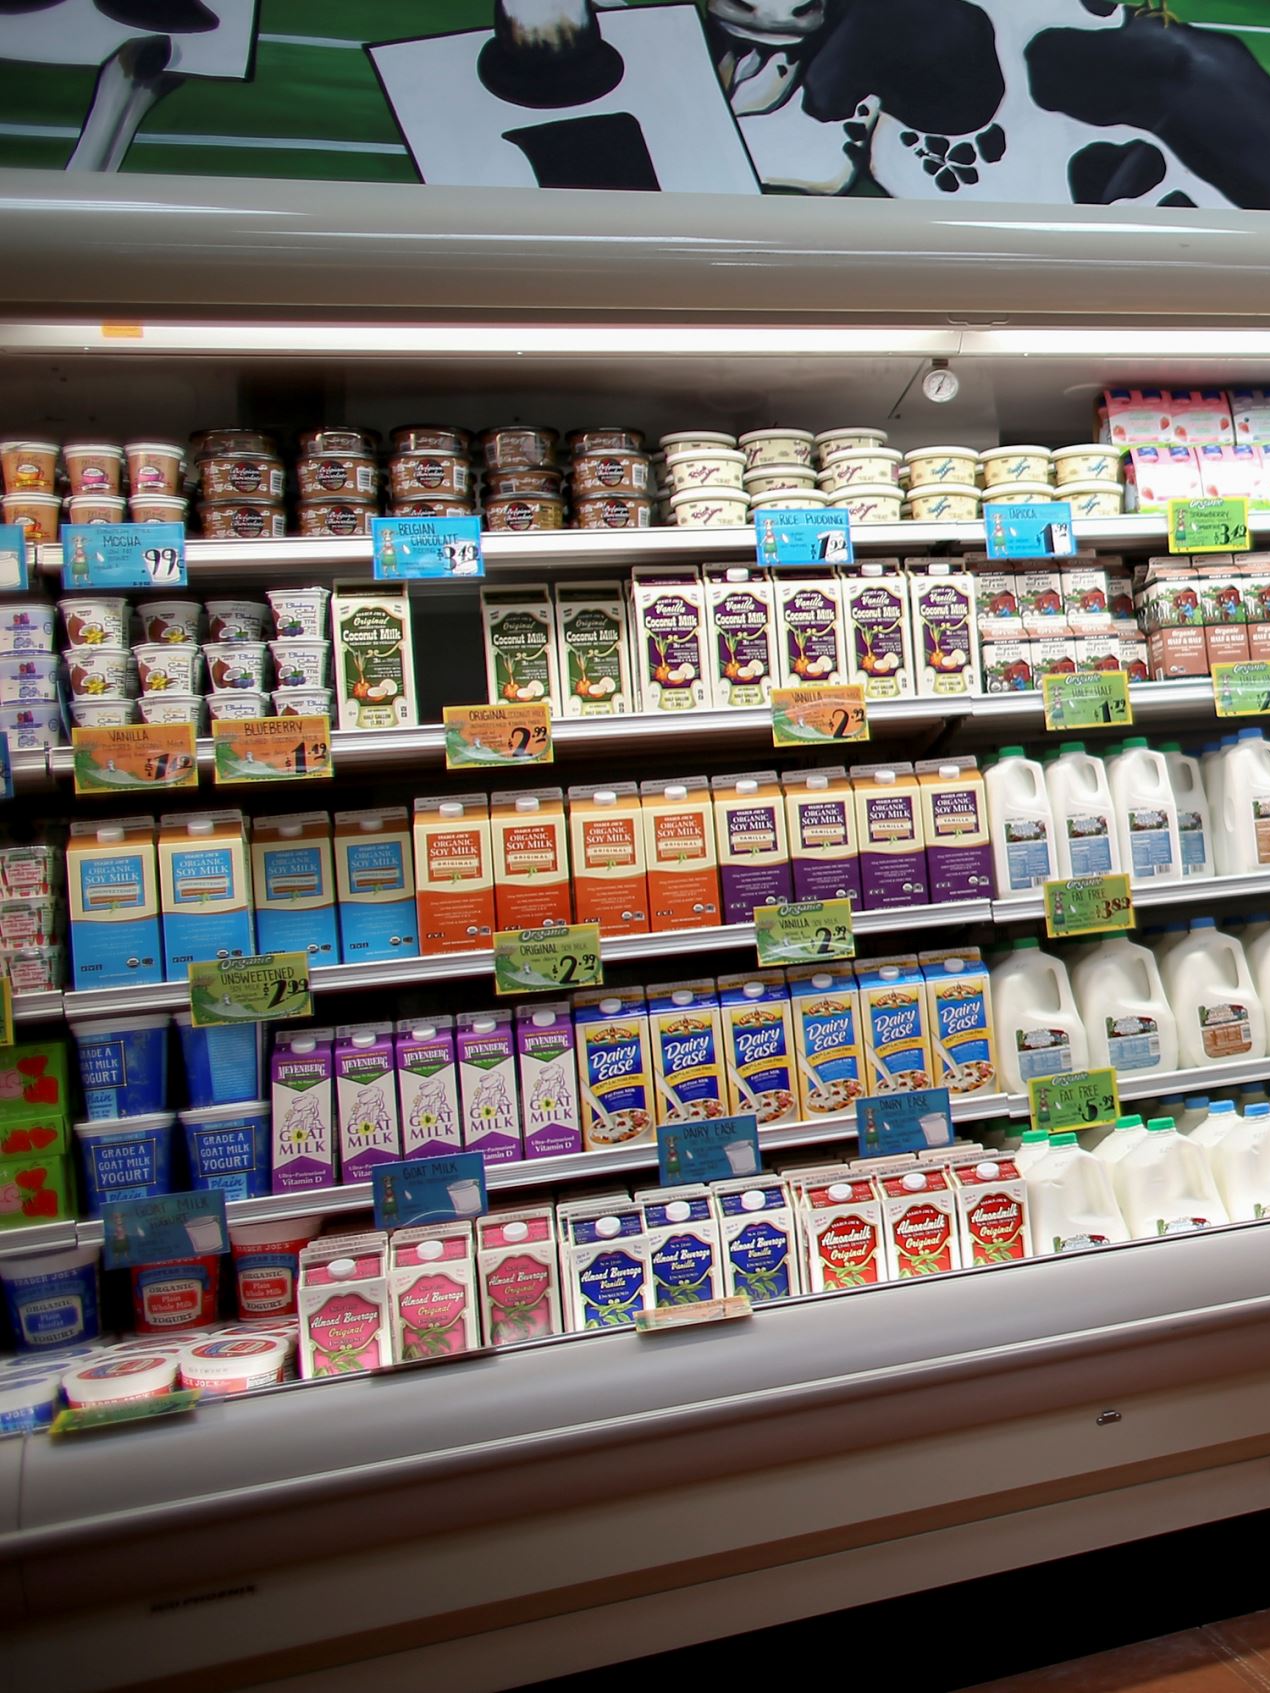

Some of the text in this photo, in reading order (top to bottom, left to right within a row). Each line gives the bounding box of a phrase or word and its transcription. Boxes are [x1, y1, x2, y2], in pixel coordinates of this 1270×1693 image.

[779, 513, 844, 525] RICE PUDDING
[1008, 508, 1037, 519] TAPIOCA
[398, 523, 435, 536] BELGIAN
[103, 535, 142, 547] MOCHA
[411, 533, 458, 546] CHOCOLATE
[795, 596, 824, 608] Vanilla
[929, 591, 958, 603] Vanilla
[655, 600, 685, 614] Vanilla
[725, 597, 755, 611] Vanilla
[920, 604, 968, 616] Coconut Milk
[353, 616, 390, 626] Original
[645, 615, 697, 627] Coconut Milk
[715, 612, 766, 624] Coconut Milk
[785, 609, 835, 621] Coconut Milk
[343, 628, 401, 641] Coconut Milk
[493, 632, 546, 645] Coconut Milk
[469, 710, 506, 721] ORIGINAL
[244, 720, 303, 736] BLUEBERRY
[108, 730, 149, 742] VANILLA
[937, 798, 971, 806] ORGANIC
[934, 804, 975, 815] SOY MILK
[732, 814, 768, 823] ORGANIC
[730, 820, 773, 832] SOY MILK
[433, 838, 473, 848] ORGANIC
[509, 832, 549, 842] ORGANIC
[430, 845, 479, 857] SOY MILK
[506, 839, 553, 850] SOY MILK
[179, 858, 224, 867] ORGANIC
[88, 865, 135, 875] ORGANIC
[176, 865, 229, 877] SOY MILK
[85, 872, 139, 884] SOY MILK
[1071, 888, 1107, 902] FAT FREE
[780, 903, 821, 915] Organic
[779, 918, 810, 929] VANILLA
[522, 928, 568, 940] Organic
[520, 943, 558, 956] ORIGINAL
[221, 956, 272, 969] Organic
[220, 966, 295, 985] UNSWEETENED
[941, 1001, 981, 1023] Dairy
[874, 1009, 916, 1032] Dairy
[947, 1014, 978, 1034] Ease
[806, 1017, 849, 1040] Dairy
[881, 1023, 914, 1043] Ease
[525, 1034, 568, 1051] MEYENBERG
[737, 1027, 780, 1051] Dairy
[814, 1031, 847, 1051] Ease
[664, 1036, 709, 1060] Dairy
[744, 1041, 778, 1062] Ease
[403, 1049, 449, 1066] MEYENBERG
[590, 1044, 636, 1069] Dairy
[672, 1050, 707, 1071] Ease
[278, 1063, 326, 1079] MEYENBERG
[598, 1059, 634, 1080] Ease
[1060, 1084, 1100, 1101] FAT FREE
[531, 1109, 573, 1123] MILK
[411, 1124, 454, 1140] MILK
[714, 1122, 737, 1136] EASE
[203, 1133, 245, 1145] GRADE A
[102, 1145, 145, 1158] GRADE A
[200, 1143, 250, 1158] GOAT MILK
[279, 1140, 326, 1156] MILK
[535, 1141, 572, 1153] Vitamin D
[98, 1156, 150, 1171] GOAT MILK
[202, 1155, 248, 1171] YOGURT
[101, 1168, 149, 1184] YOGURT
[403, 1162, 458, 1179] GOAT MILK
[282, 1177, 313, 1186] Vitamin
[971, 1204, 1018, 1223] Almondmilk
[896, 1214, 945, 1235] Almondmilk
[980, 1222, 1013, 1237] Original
[822, 1226, 872, 1246] Almondmilk
[905, 1234, 940, 1249] Original
[730, 1236, 786, 1252] Almond Beverage
[748, 1249, 771, 1258] Vanilla
[830, 1245, 866, 1261] Original
[581, 1266, 642, 1283] Almond Beverage
[149, 1282, 195, 1293] ORGANIC
[601, 1279, 626, 1289] Vanilla
[401, 1291, 464, 1307] Almond Beverage
[418, 1305, 451, 1316] Original
[152, 1312, 193, 1324] YOGURT
[311, 1312, 378, 1328] Almond Beverage
[328, 1326, 364, 1337] Original
